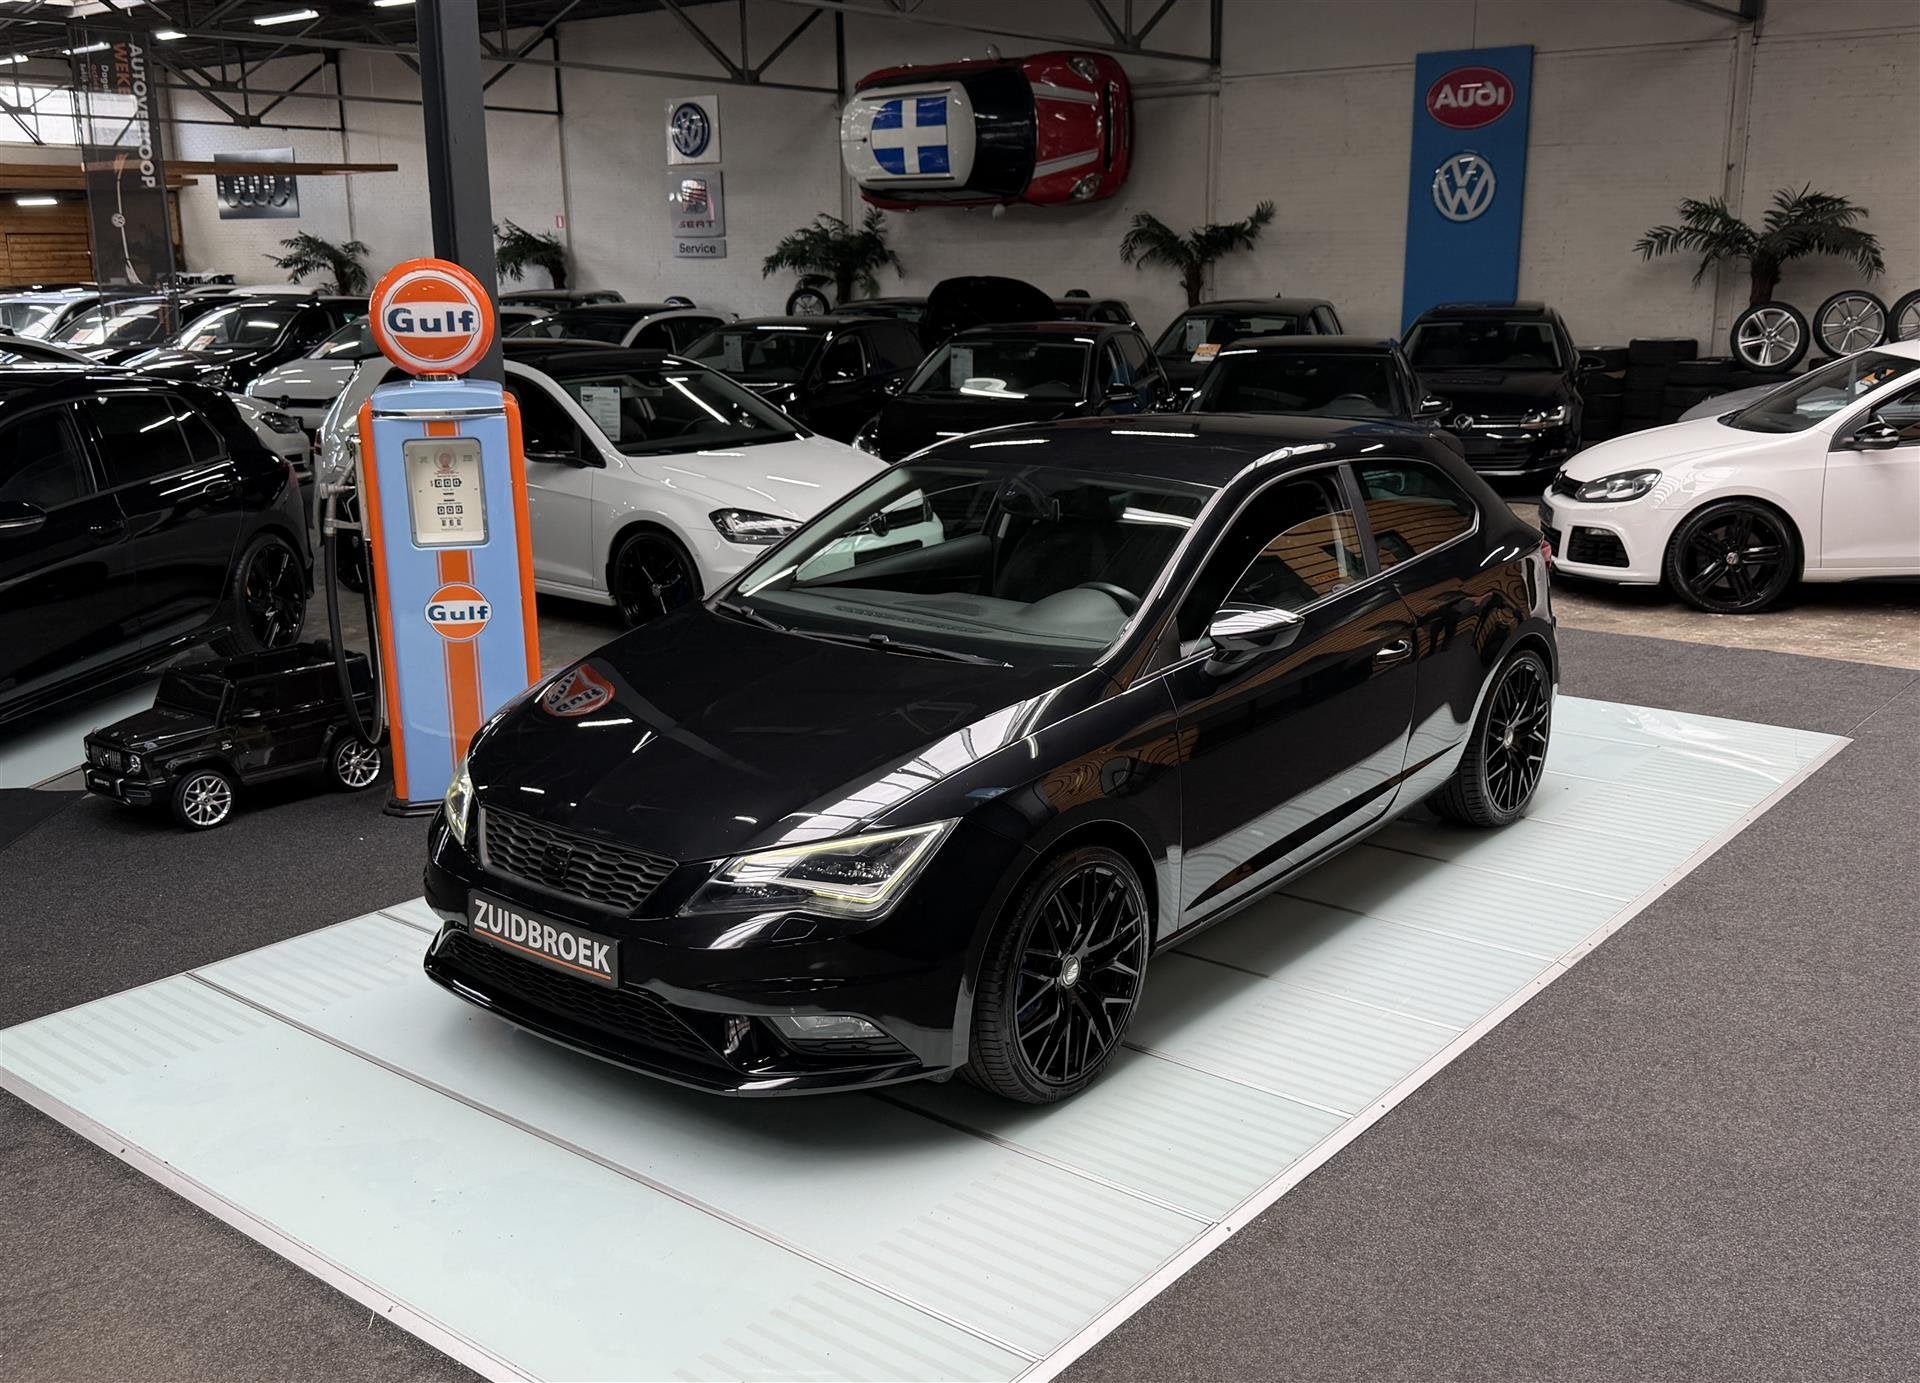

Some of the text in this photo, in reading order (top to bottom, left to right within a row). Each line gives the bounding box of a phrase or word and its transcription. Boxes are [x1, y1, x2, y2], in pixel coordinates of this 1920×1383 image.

[679, 242, 717, 254] Service
[387, 307, 475, 332] Gulf
[427, 604, 489, 621] Gulf
[473, 899, 612, 974] ZUIDBROEK
